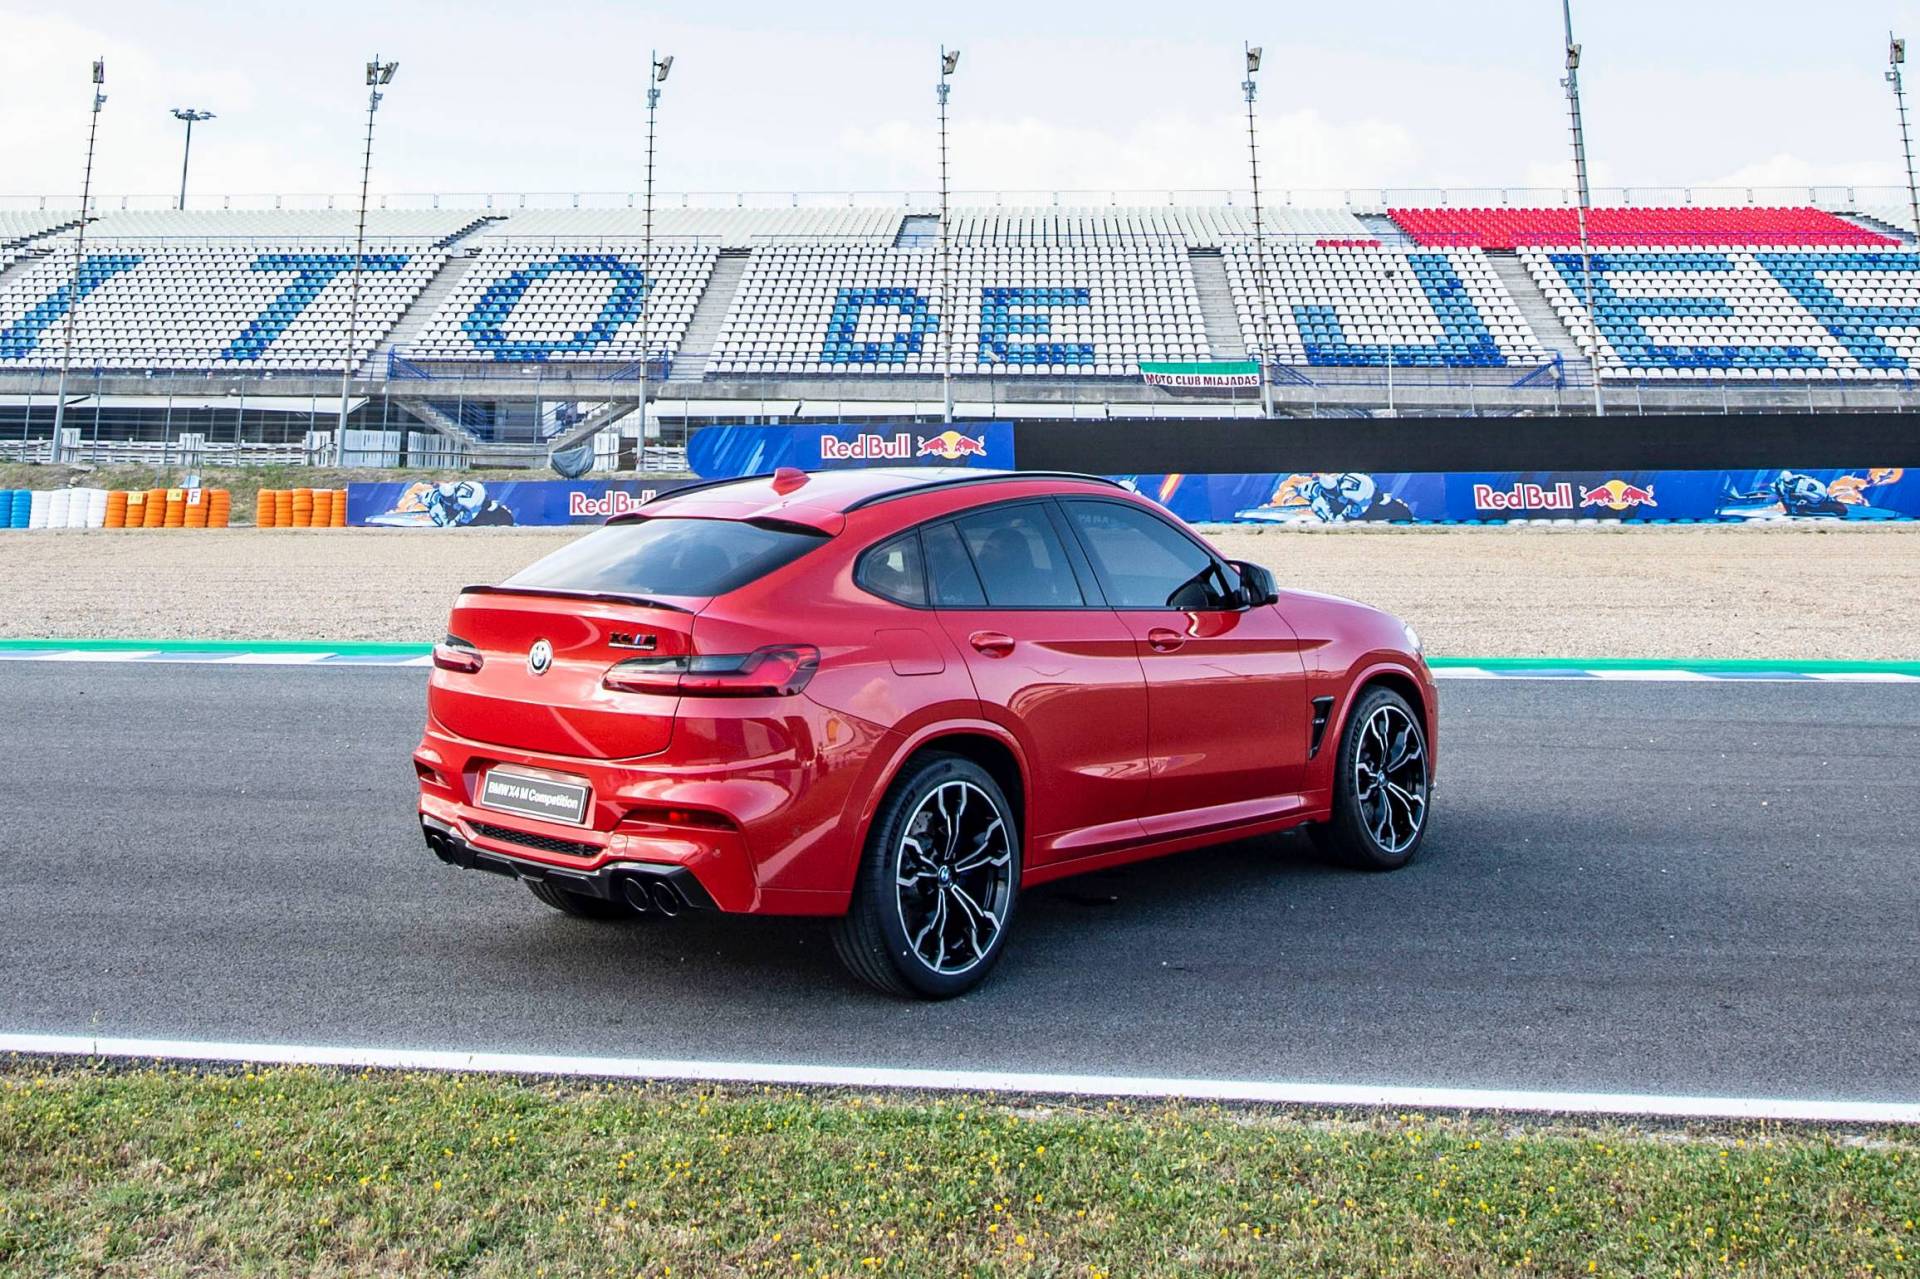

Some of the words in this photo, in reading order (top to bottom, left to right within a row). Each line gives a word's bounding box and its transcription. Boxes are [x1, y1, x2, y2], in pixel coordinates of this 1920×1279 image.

[820, 287, 1094, 365] DE
[1145, 374, 1173, 385] MOTO
[1175, 375, 1201, 386] CLUB
[1203, 375, 1258, 386] MIAJADAS
[822, 434, 865, 458] Red
[868, 434, 910, 458] Bull
[570, 491, 613, 515] Red
[1475, 484, 1523, 509] Red
[1526, 483, 1572, 508] Bull
[488, 781, 509, 796] BMW
[508, 785, 520, 799] X4
[520, 786, 529, 801] M
[529, 788, 578, 809] Competition
